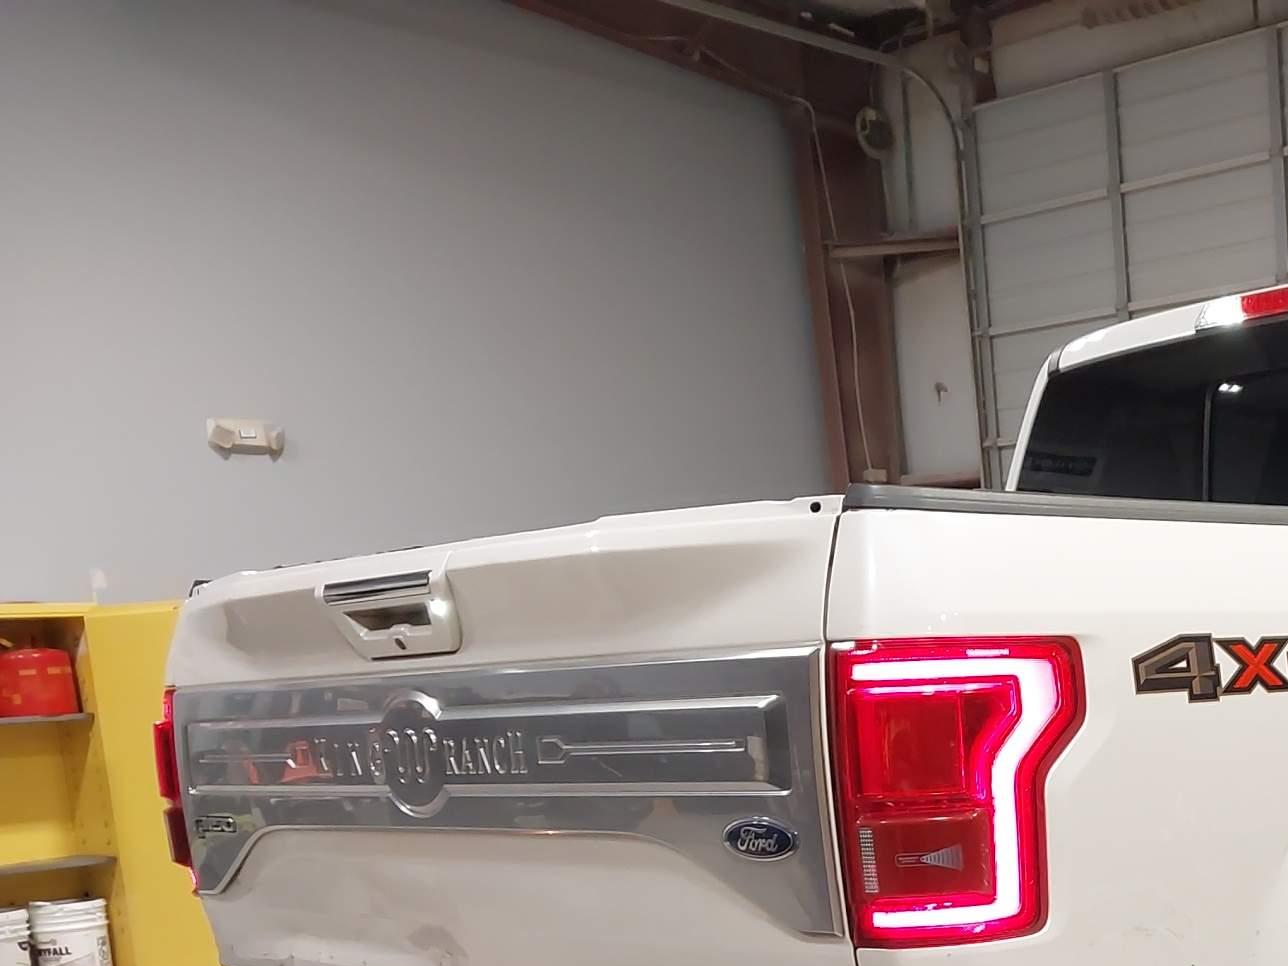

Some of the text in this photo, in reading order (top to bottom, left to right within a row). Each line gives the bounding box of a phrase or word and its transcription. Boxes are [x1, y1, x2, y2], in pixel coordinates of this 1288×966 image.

[313, 731, 529, 778] KING RANCH
[737, 826, 778, 852] Ford
